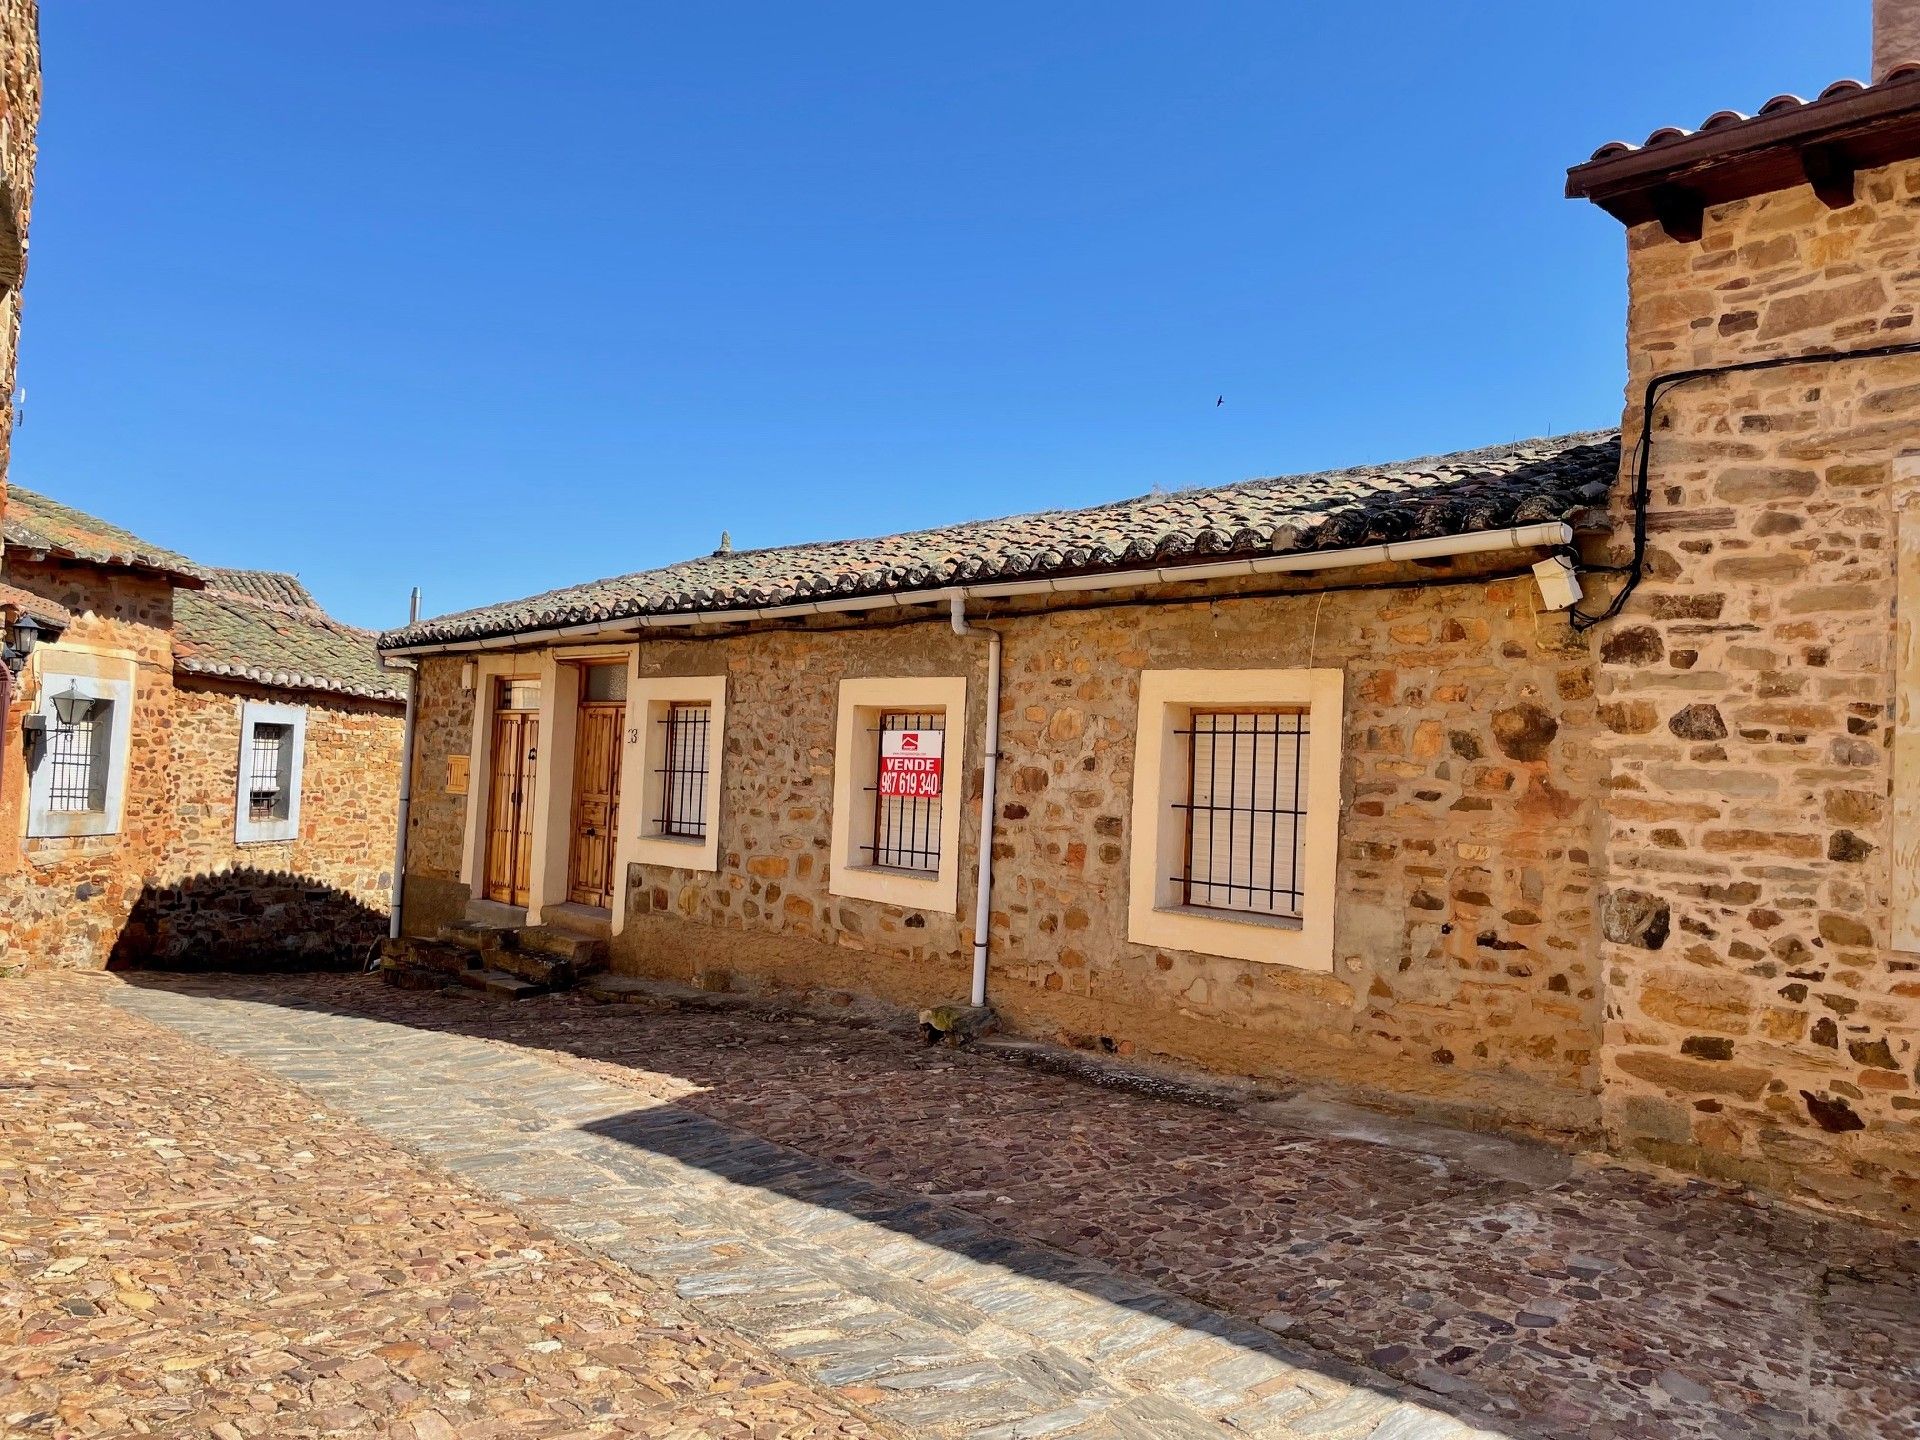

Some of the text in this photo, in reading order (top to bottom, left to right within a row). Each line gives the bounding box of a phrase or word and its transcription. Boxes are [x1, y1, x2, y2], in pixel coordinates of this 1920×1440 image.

[886, 758, 935, 771] VENDE
[881, 772, 938, 795] 987 619 340
